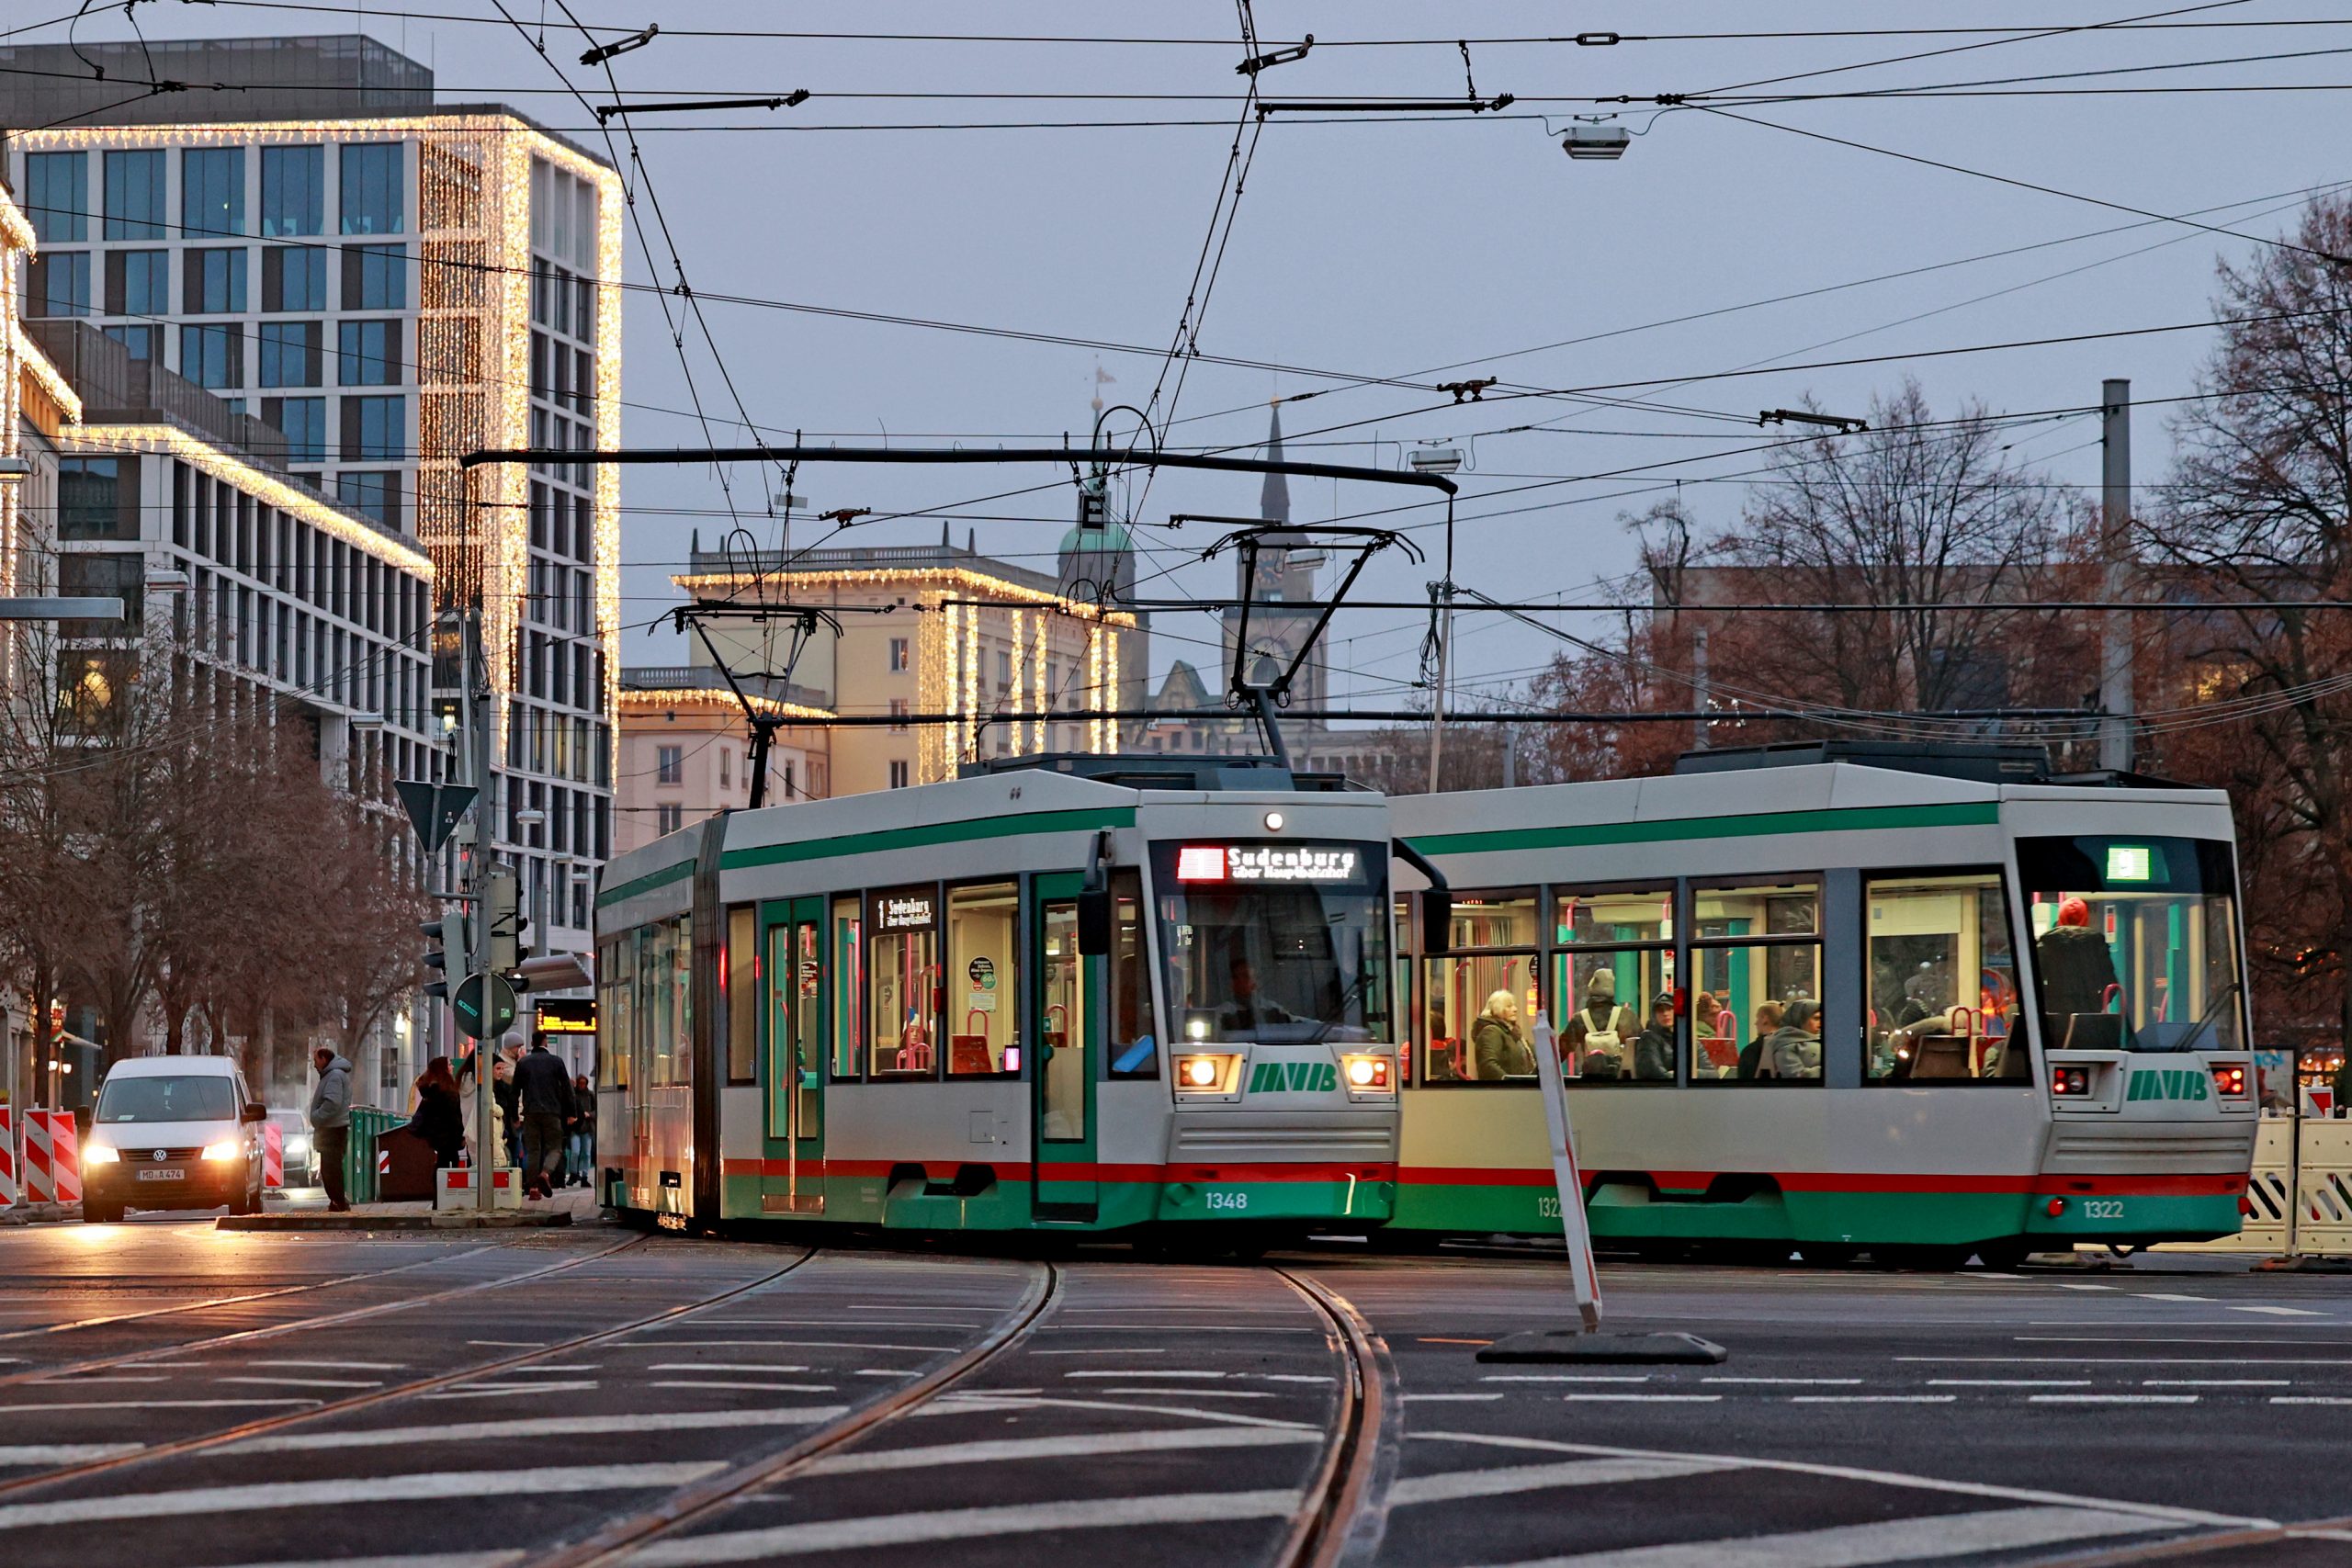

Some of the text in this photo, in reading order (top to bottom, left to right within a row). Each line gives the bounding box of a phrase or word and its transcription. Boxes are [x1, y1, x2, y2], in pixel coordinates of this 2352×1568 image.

[1082, 495, 1104, 529] E
[1227, 848, 1355, 867] Sudenburg
[1232, 866, 1262, 878] über
[878, 900, 884, 929] 1
[165, 1170, 181, 1179] 474
[1205, 1192, 1248, 1209] 1348
[2083, 1201, 2124, 1218] 1322
